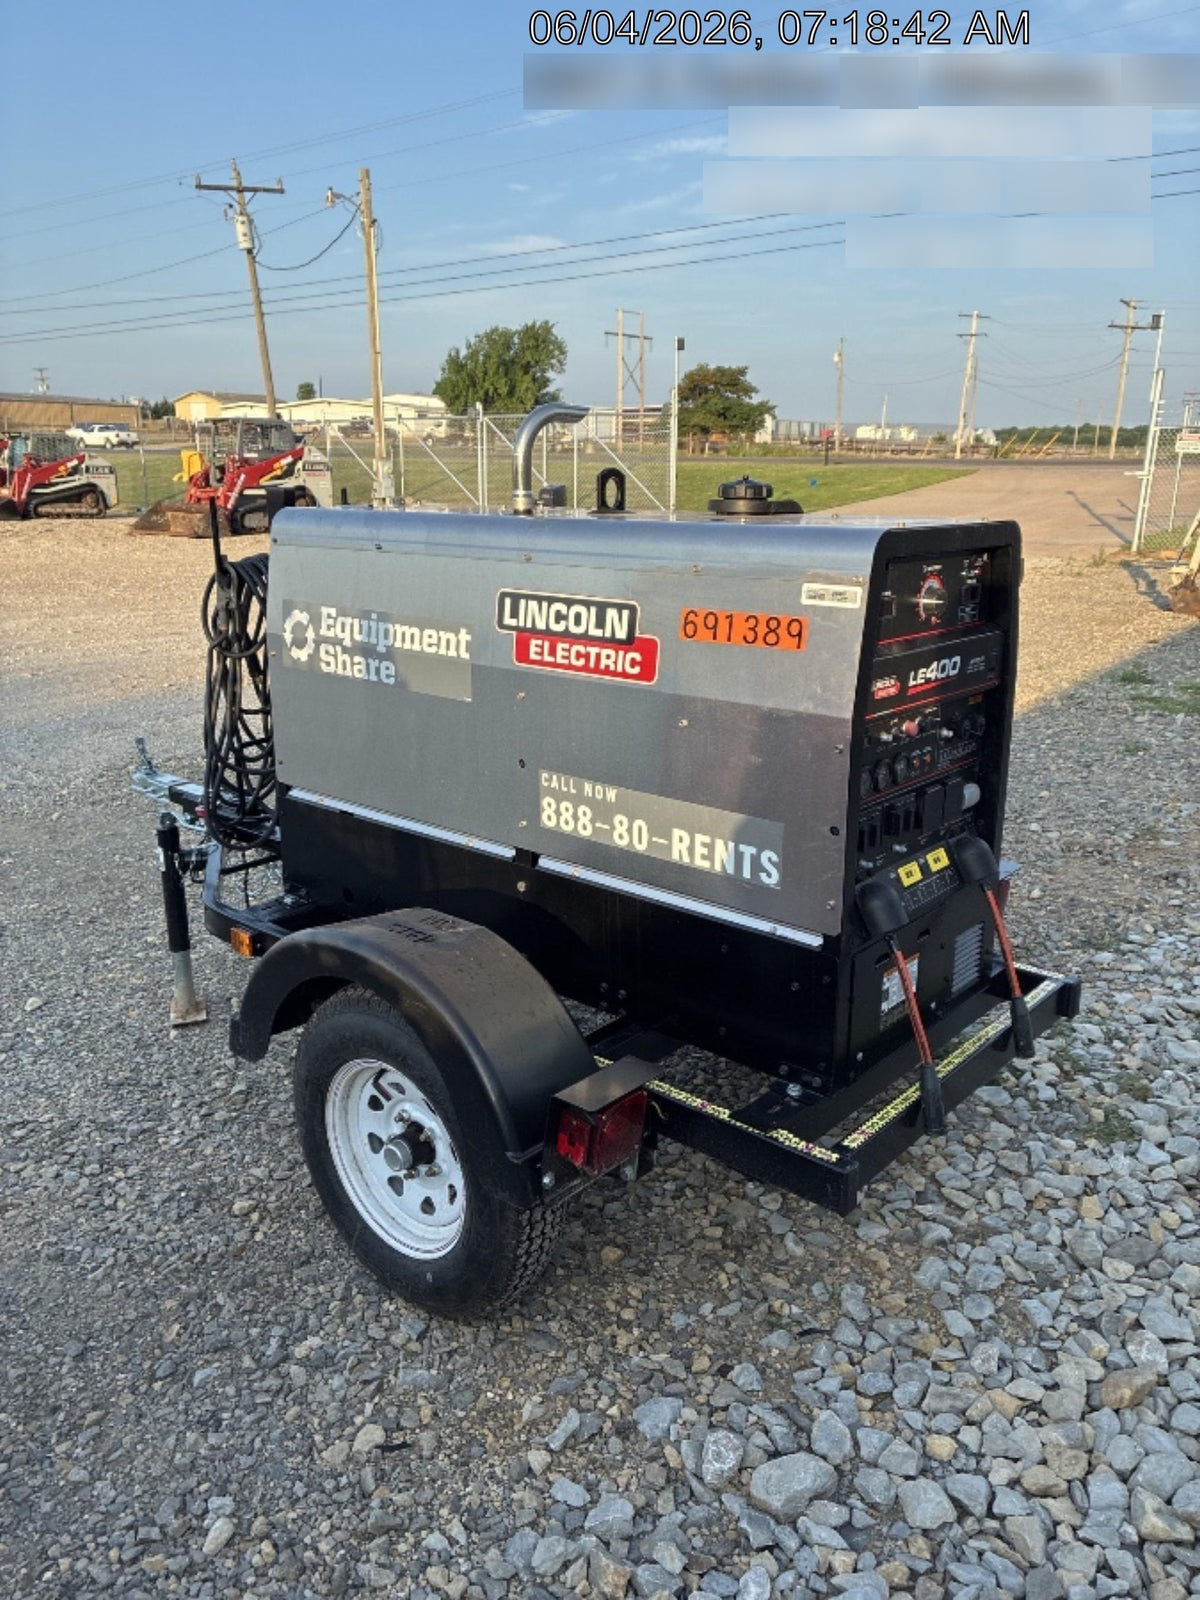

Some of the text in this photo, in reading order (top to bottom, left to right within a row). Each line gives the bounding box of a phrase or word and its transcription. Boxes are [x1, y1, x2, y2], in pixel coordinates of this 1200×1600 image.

[320, 606, 471, 659] Equipment
[502, 597, 629, 640] LINCOLN
[683, 610, 805, 650] 691389
[320, 643, 395, 685] Share
[529, 638, 642, 674] ELECTRIC
[909, 656, 961, 687] LE400
[541, 773, 618, 803] CALL NOW
[541, 797, 780, 886] 888-80-RENTS
